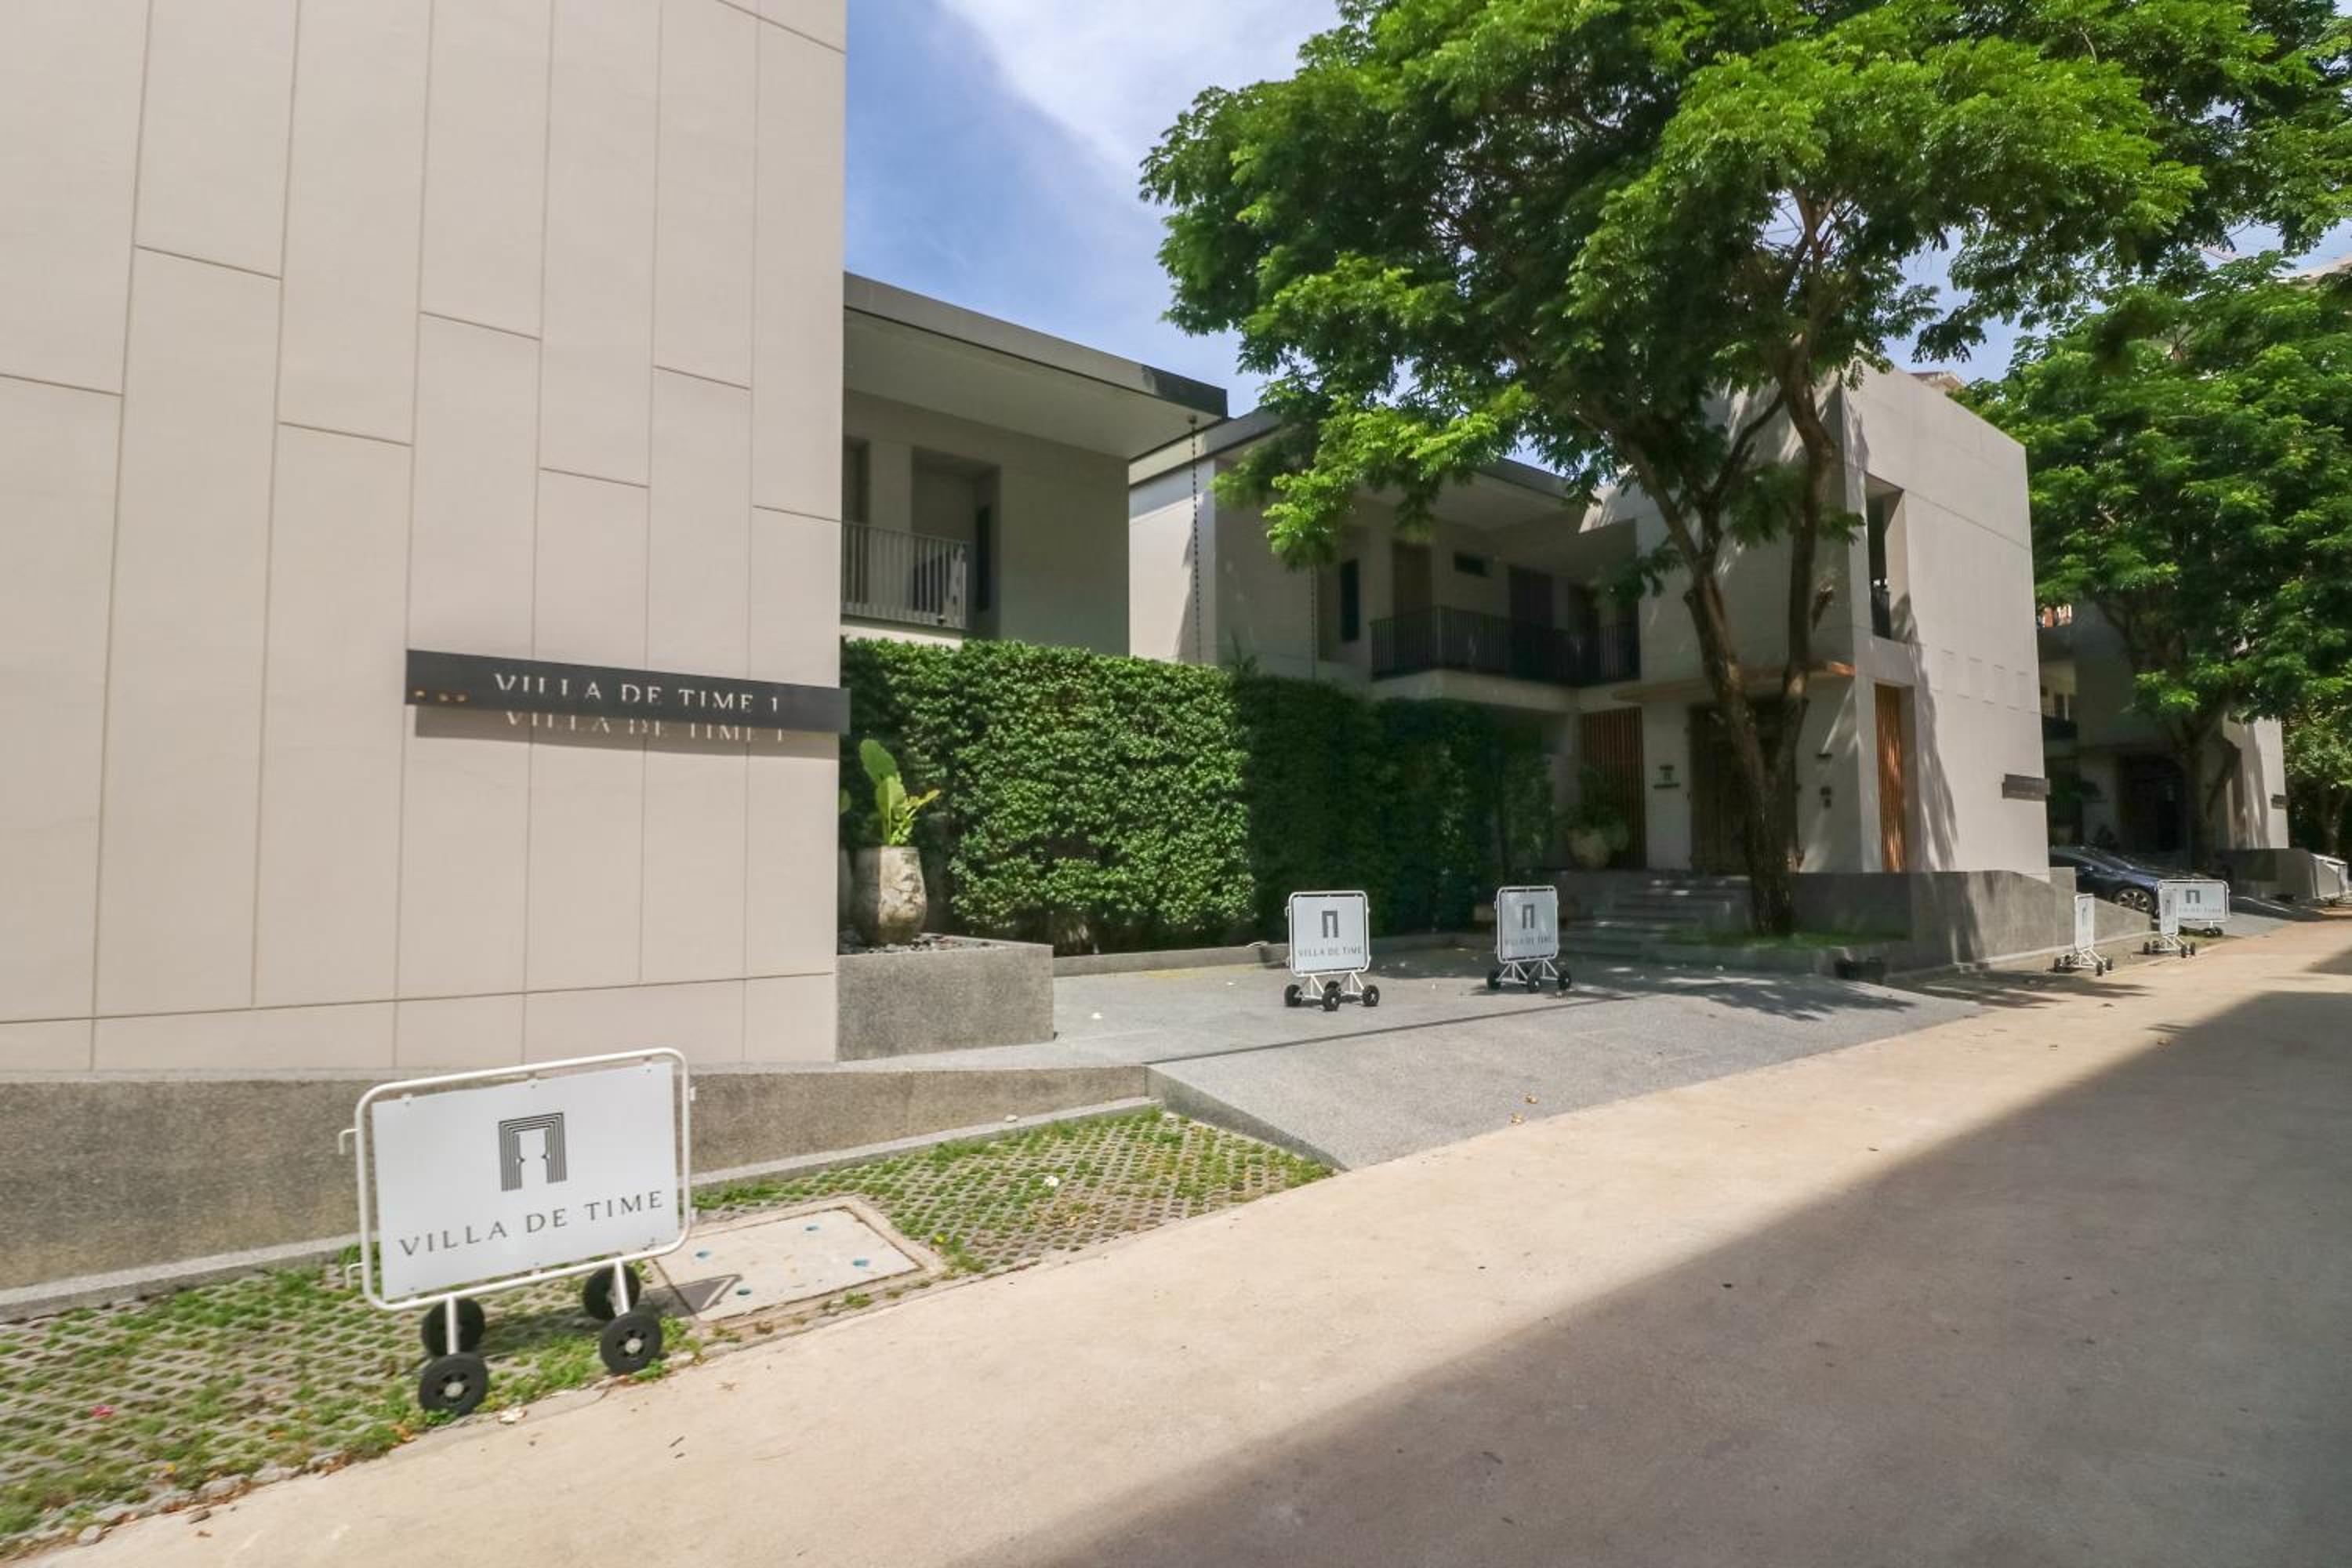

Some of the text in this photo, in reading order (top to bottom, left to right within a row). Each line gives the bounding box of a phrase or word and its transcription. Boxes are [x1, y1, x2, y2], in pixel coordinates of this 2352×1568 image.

[495, 673, 602, 699] VILLA
[621, 683, 662, 704] DE
[678, 688, 754, 712] TIME
[399, 1190, 663, 1257] VILLA DE TIME
